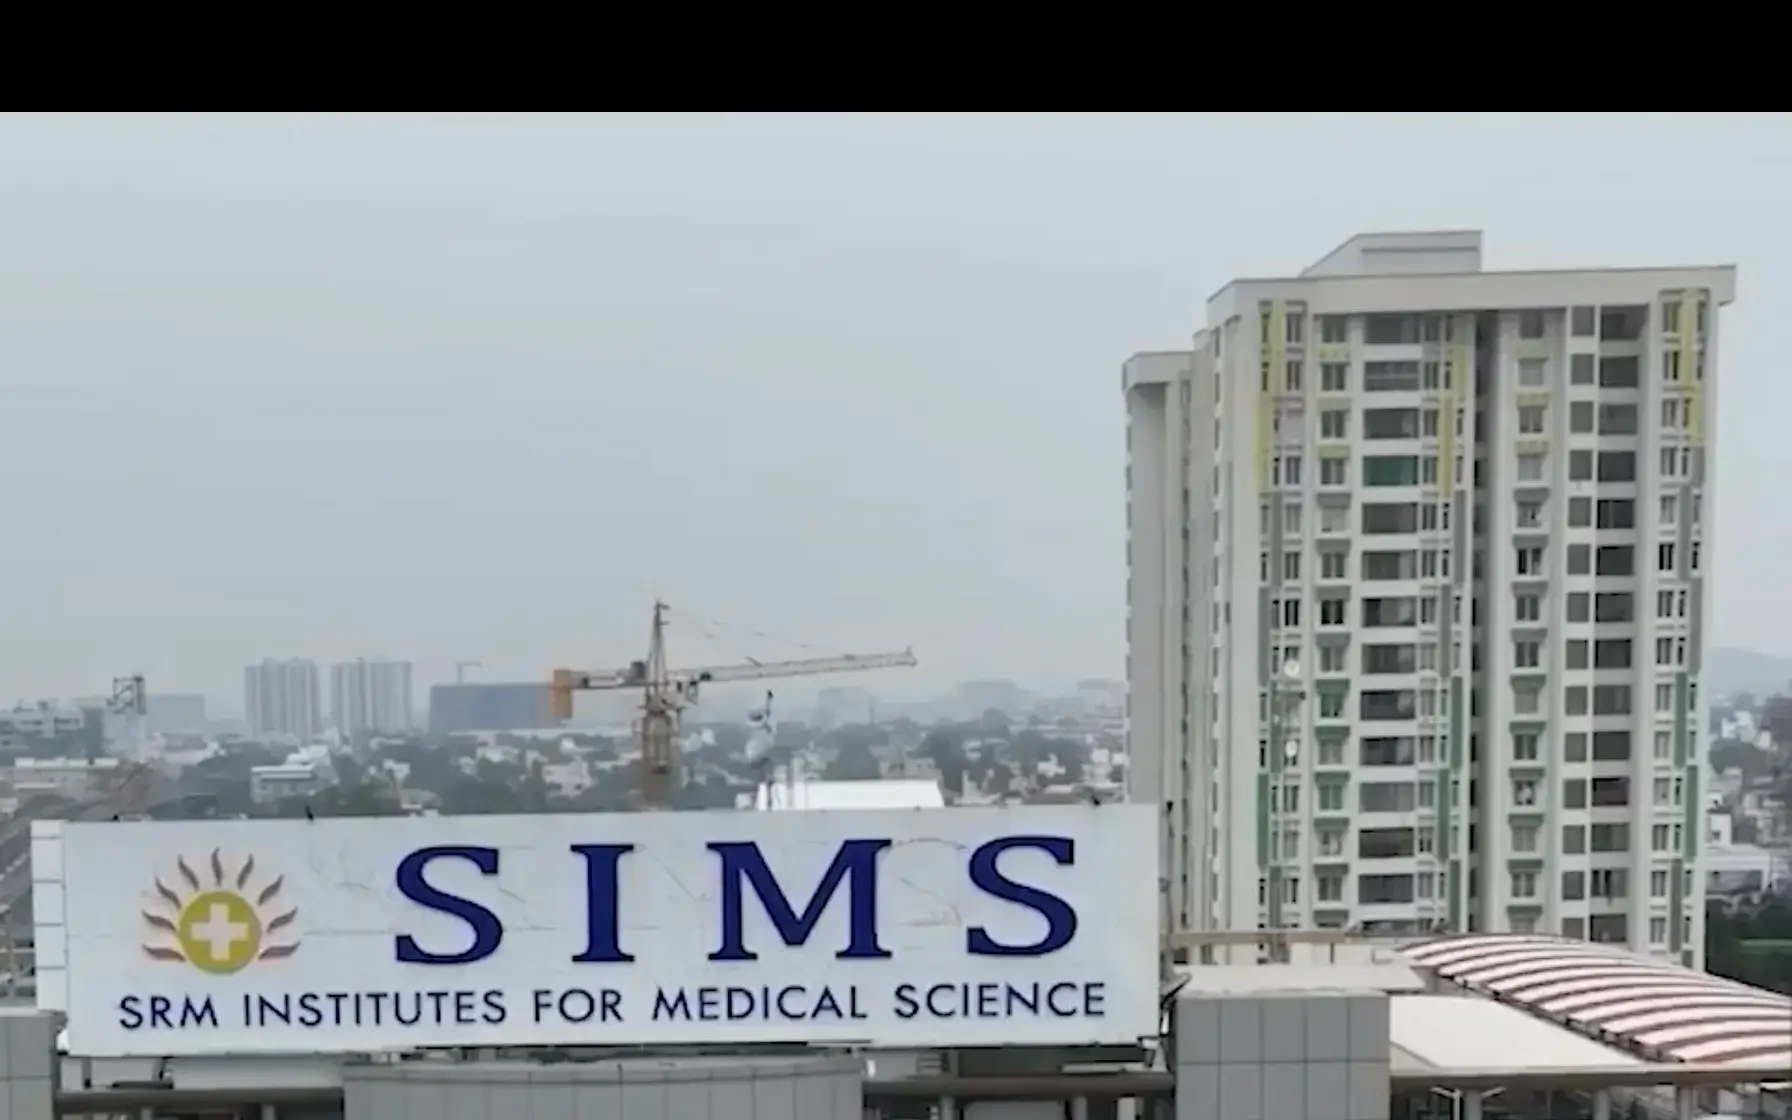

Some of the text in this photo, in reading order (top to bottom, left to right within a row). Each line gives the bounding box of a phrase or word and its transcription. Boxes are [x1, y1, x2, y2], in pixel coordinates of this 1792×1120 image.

[393, 835, 1079, 966] SIMS
[118, 982, 1106, 1031] SRM INSTITUTES FOR MEDICAL SCIENCE
